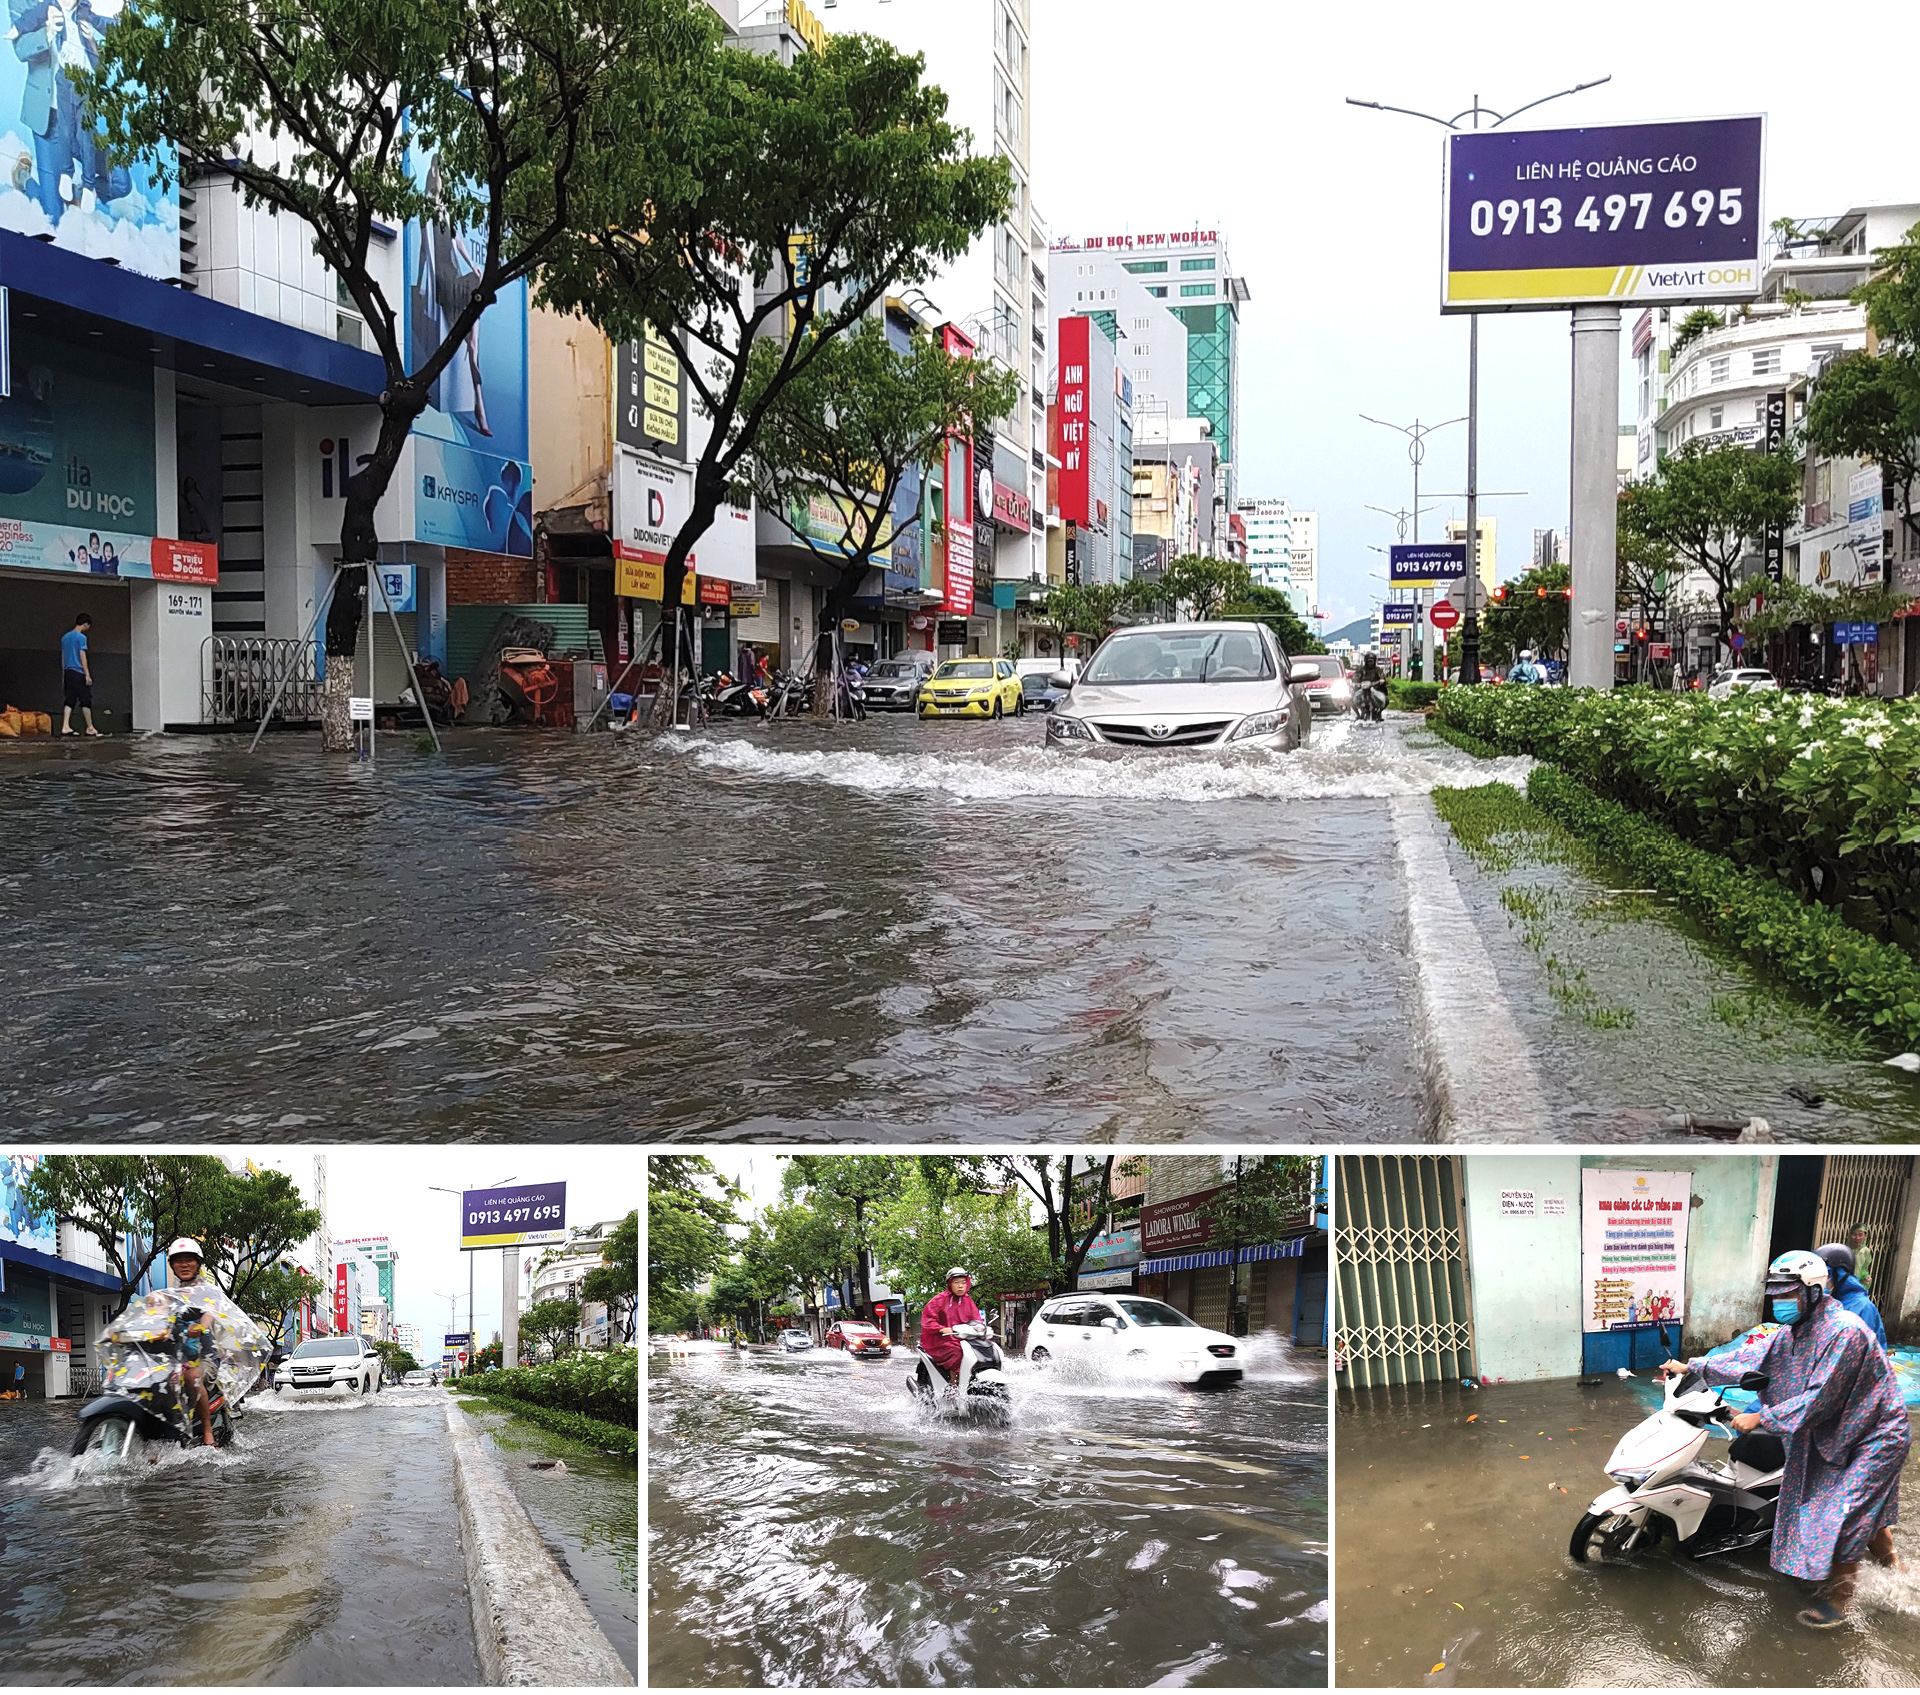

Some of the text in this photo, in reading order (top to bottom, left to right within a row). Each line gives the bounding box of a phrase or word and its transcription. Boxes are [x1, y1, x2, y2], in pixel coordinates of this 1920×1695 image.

[1516, 154, 1697, 181] LIÊN HỆ QUẢNG CÁO
[1470, 188, 1742, 236] 0913 497 695
[1086, 237, 1103, 248] DU
[1137, 234, 1166, 246] NEW
[1170, 230, 1217, 243] WORLD
[1064, 365, 1083, 384] ANH
[1064, 390, 1083, 413] NGỮ
[1062, 418, 1084, 446] VIỆT
[1066, 448, 1080, 470] MỸ
[66, 456, 92, 488] ila
[66, 488, 135, 520] DU HỌC
[172, 553, 203, 572] 5 TRIỆU
[1396, 561, 1463, 572] 0913 497 695
[498, 1198, 506, 1206] HỆ
[507, 1196, 530, 1204] QUẢNG
[1154, 1202, 1190, 1216] SHOWROOM
[1502, 1201, 1514, 1209] ĐIỆN
[1614, 1198, 1630, 1211] GIẢNG
[1631, 1199, 1642, 1211] CÁC
[1655, 1197, 1670, 1211] TIẾNG
[469, 1205, 560, 1225] 0913 497 695
[1145, 1217, 1172, 1238] LADORA
[33, 1323, 45, 1332] HỌC
